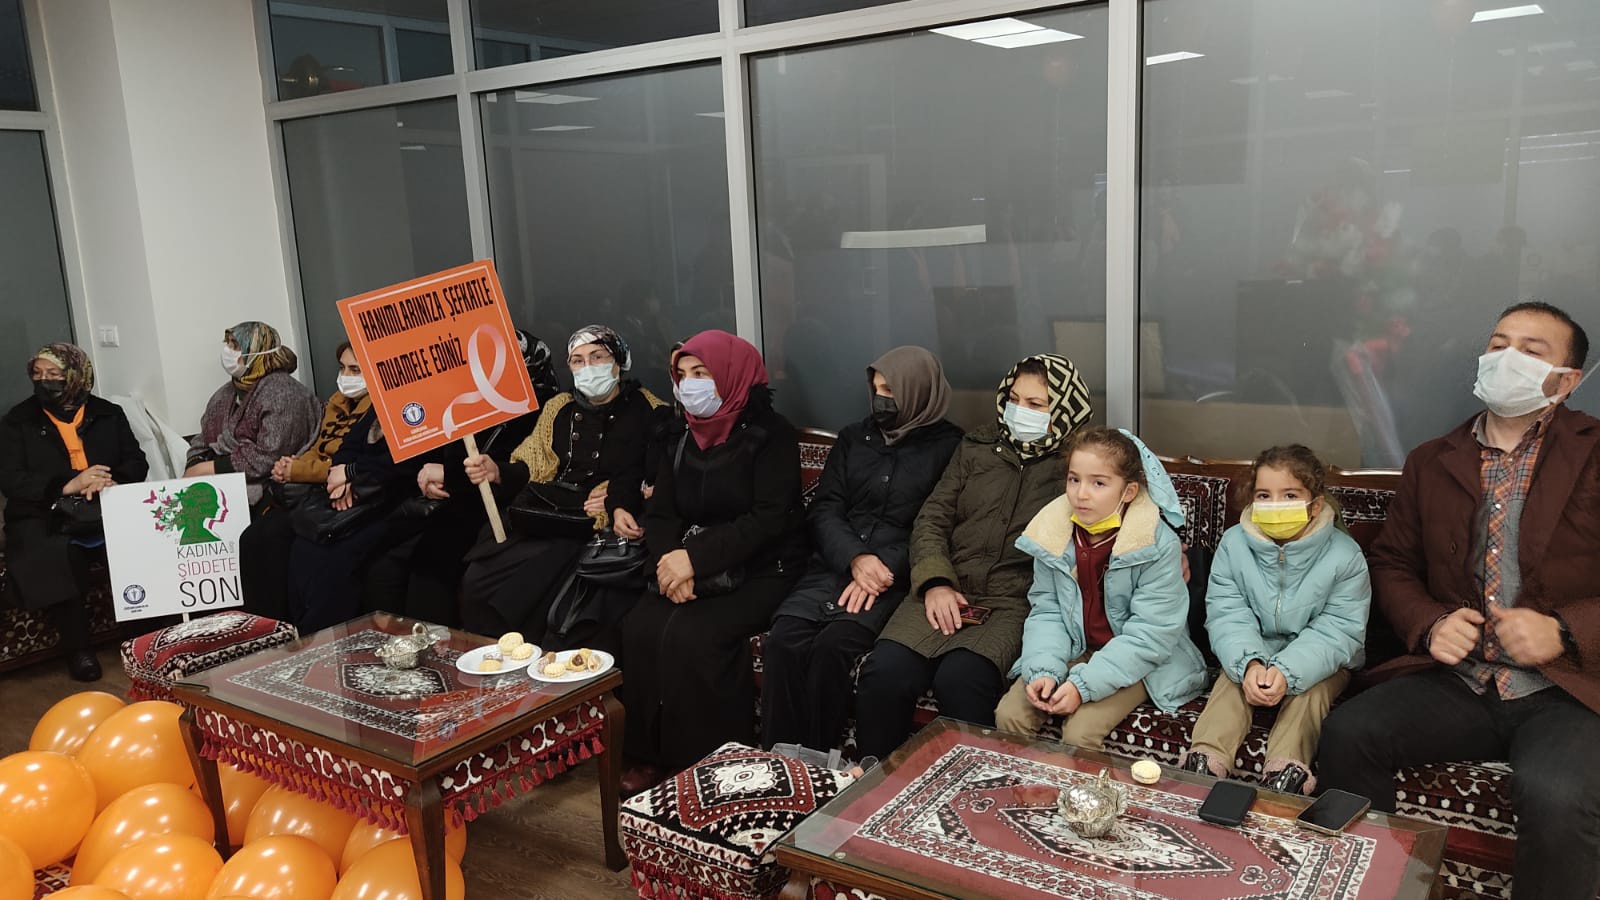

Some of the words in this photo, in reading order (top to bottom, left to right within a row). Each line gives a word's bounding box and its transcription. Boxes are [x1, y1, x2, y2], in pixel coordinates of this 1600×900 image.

[358, 291, 446, 342] HANIMLARINIZA
[442, 276, 494, 321] ŞEFKATLE
[376, 348, 432, 391] MUAMELE
[429, 333, 467, 374] EDİNİZ
[176, 541, 229, 559] KADINA
[177, 556, 237, 581] ŞİDDETE
[179, 575, 240, 607] SON
